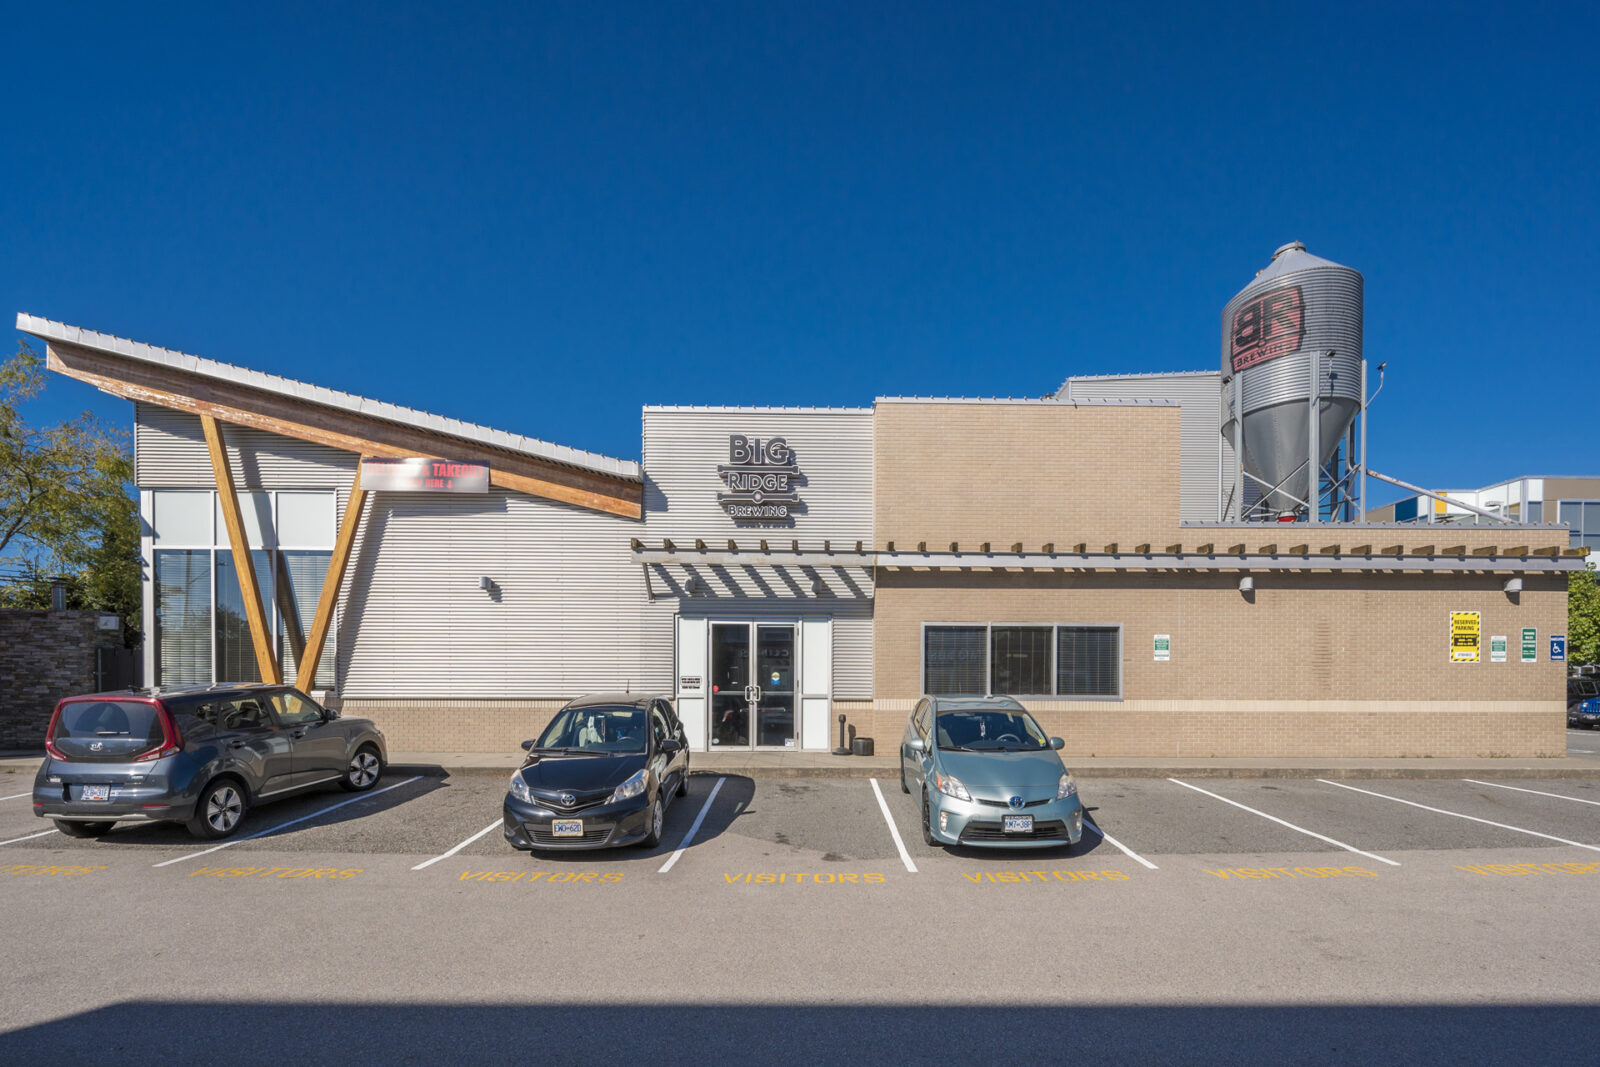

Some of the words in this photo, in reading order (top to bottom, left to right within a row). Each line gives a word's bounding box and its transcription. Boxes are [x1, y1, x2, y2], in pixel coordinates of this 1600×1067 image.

[729, 434, 789, 465] BIG
[432, 463, 483, 478] TAKEOUT
[728, 472, 788, 491] RIDGE
[728, 504, 788, 517] BREWING
[189, 867, 364, 879] VISITORS
[459, 872, 625, 883] VISITORS
[724, 873, 886, 884] VISITORS
[962, 871, 1130, 883] VISITORS
[1204, 867, 1379, 879] VISITORS
